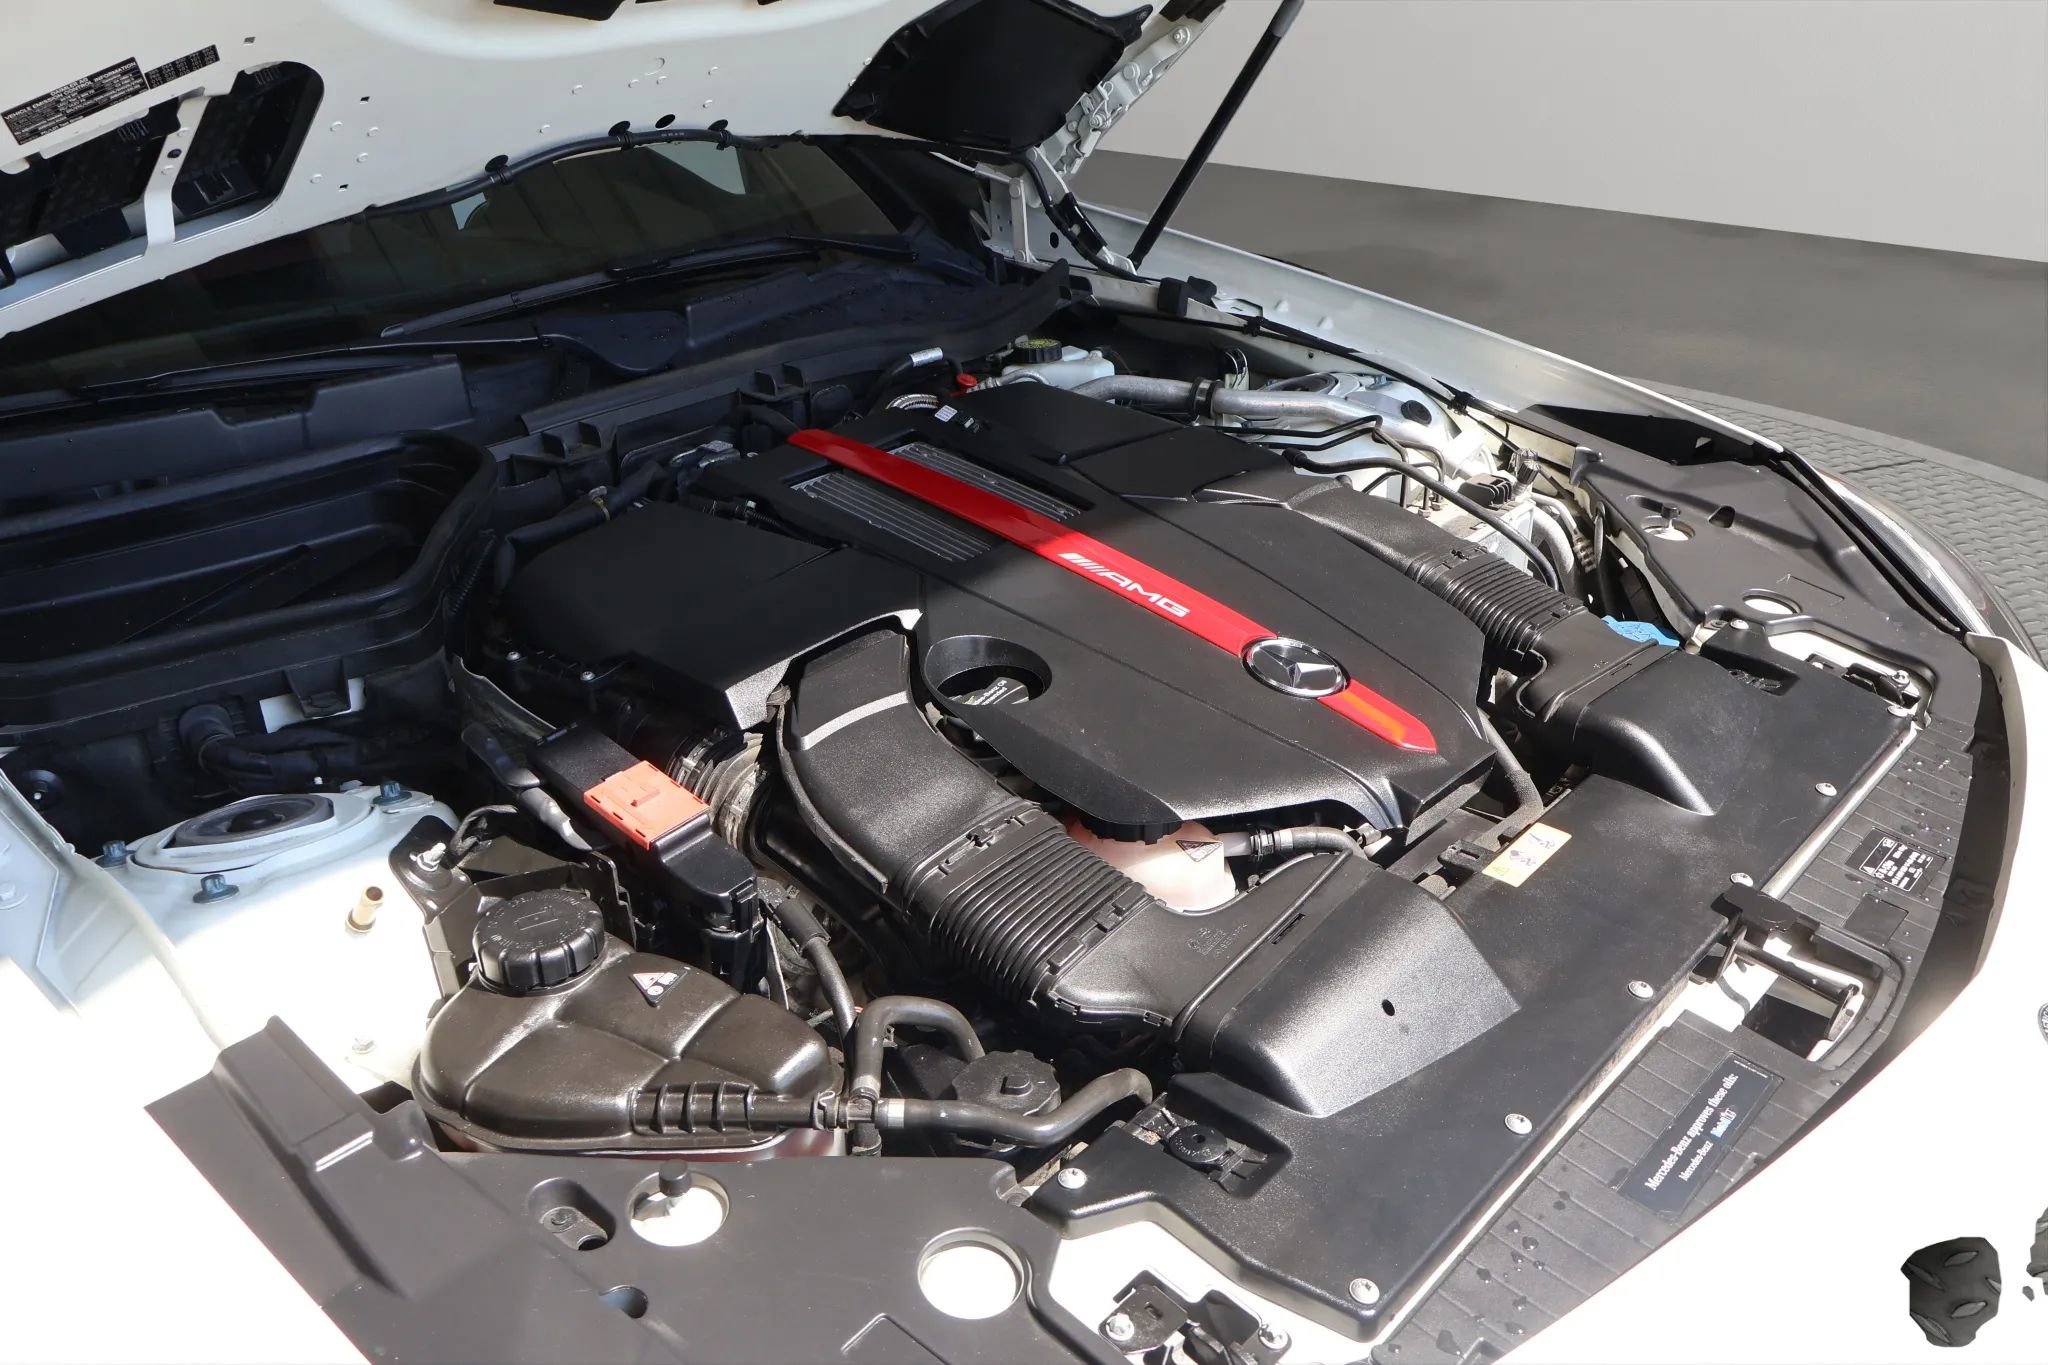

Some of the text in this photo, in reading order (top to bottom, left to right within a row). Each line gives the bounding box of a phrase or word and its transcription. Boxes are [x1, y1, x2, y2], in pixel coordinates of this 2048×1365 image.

[3, 105, 32, 120] VEHICLE
[31, 92, 63, 109] EMISSION
[62, 80, 92, 95] CONTROL
[93, 61, 136, 82] INFORMATION
[49, 81, 78, 96] DAIMLER
[77, 76, 89, 84] AG
[1099, 571, 1191, 618] AMG
[1644, 1074, 1738, 1191] Mercedes-Benz approves these oils:
[1678, 1140, 1713, 1181] Mercedes-Benz
